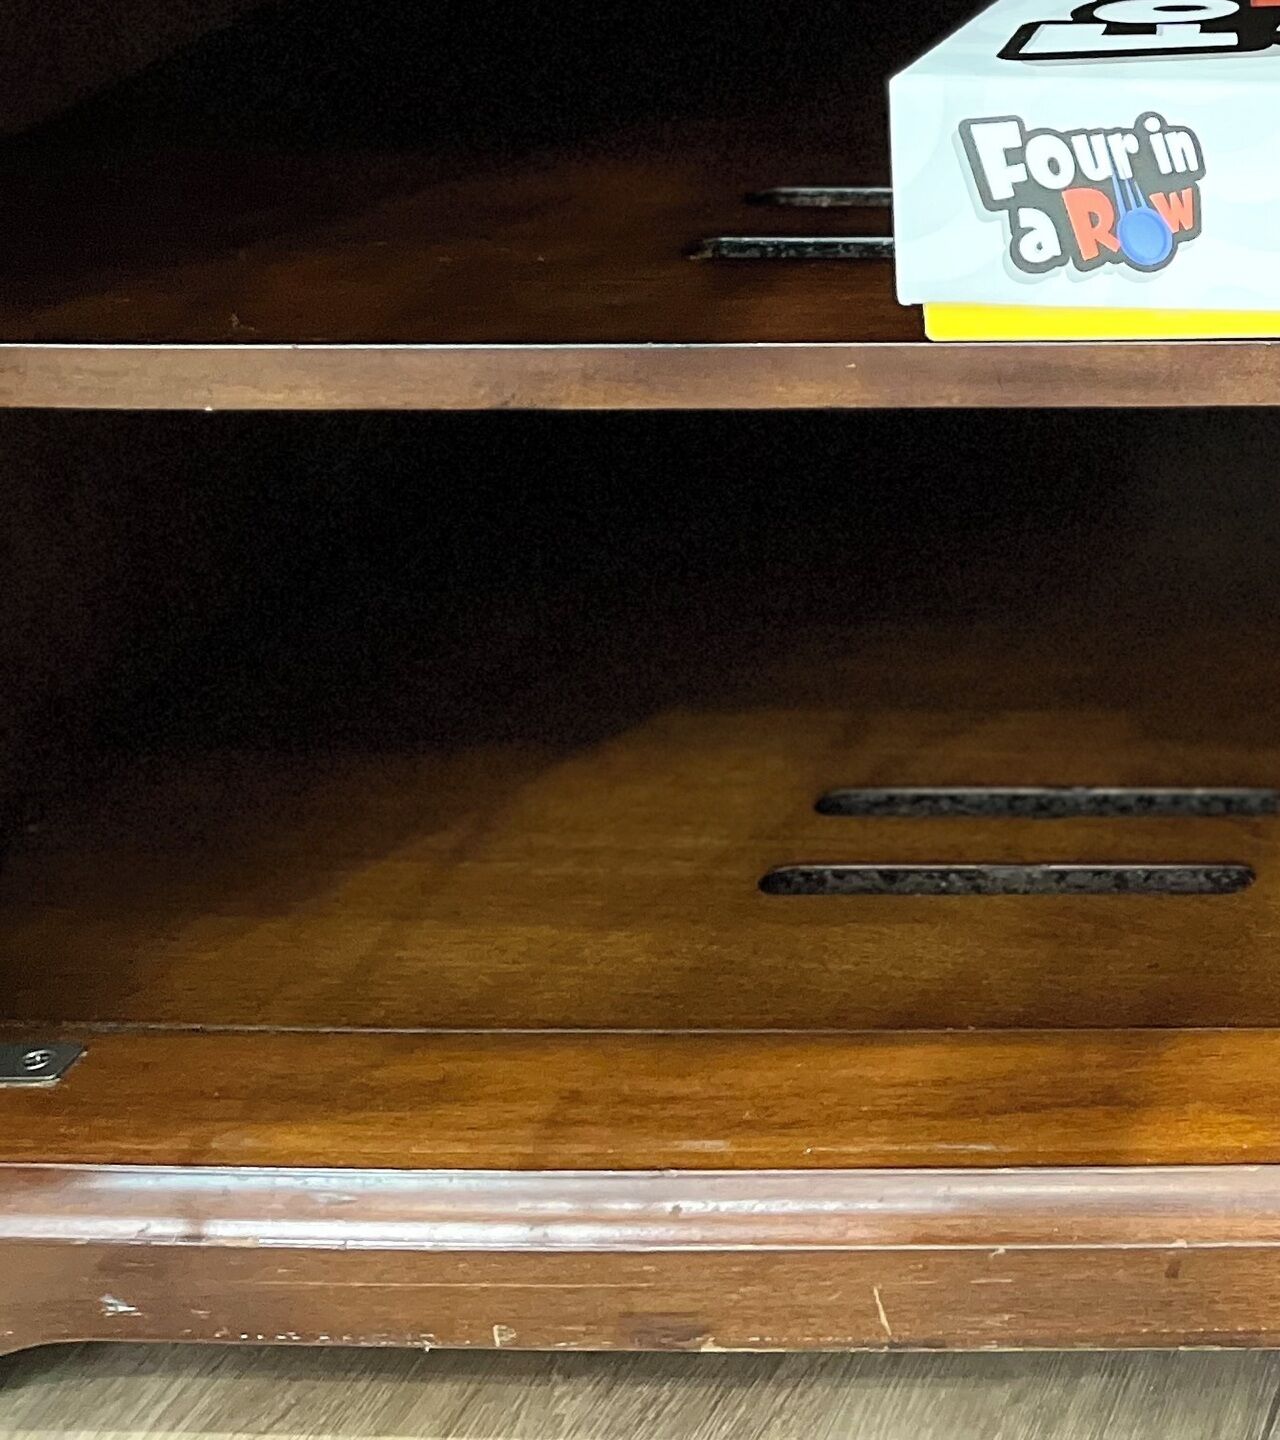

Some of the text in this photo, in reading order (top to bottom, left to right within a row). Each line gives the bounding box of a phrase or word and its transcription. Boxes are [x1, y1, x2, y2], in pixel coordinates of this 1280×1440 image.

[968, 115, 1200, 202] Four in
[1015, 206, 1062, 265] a
